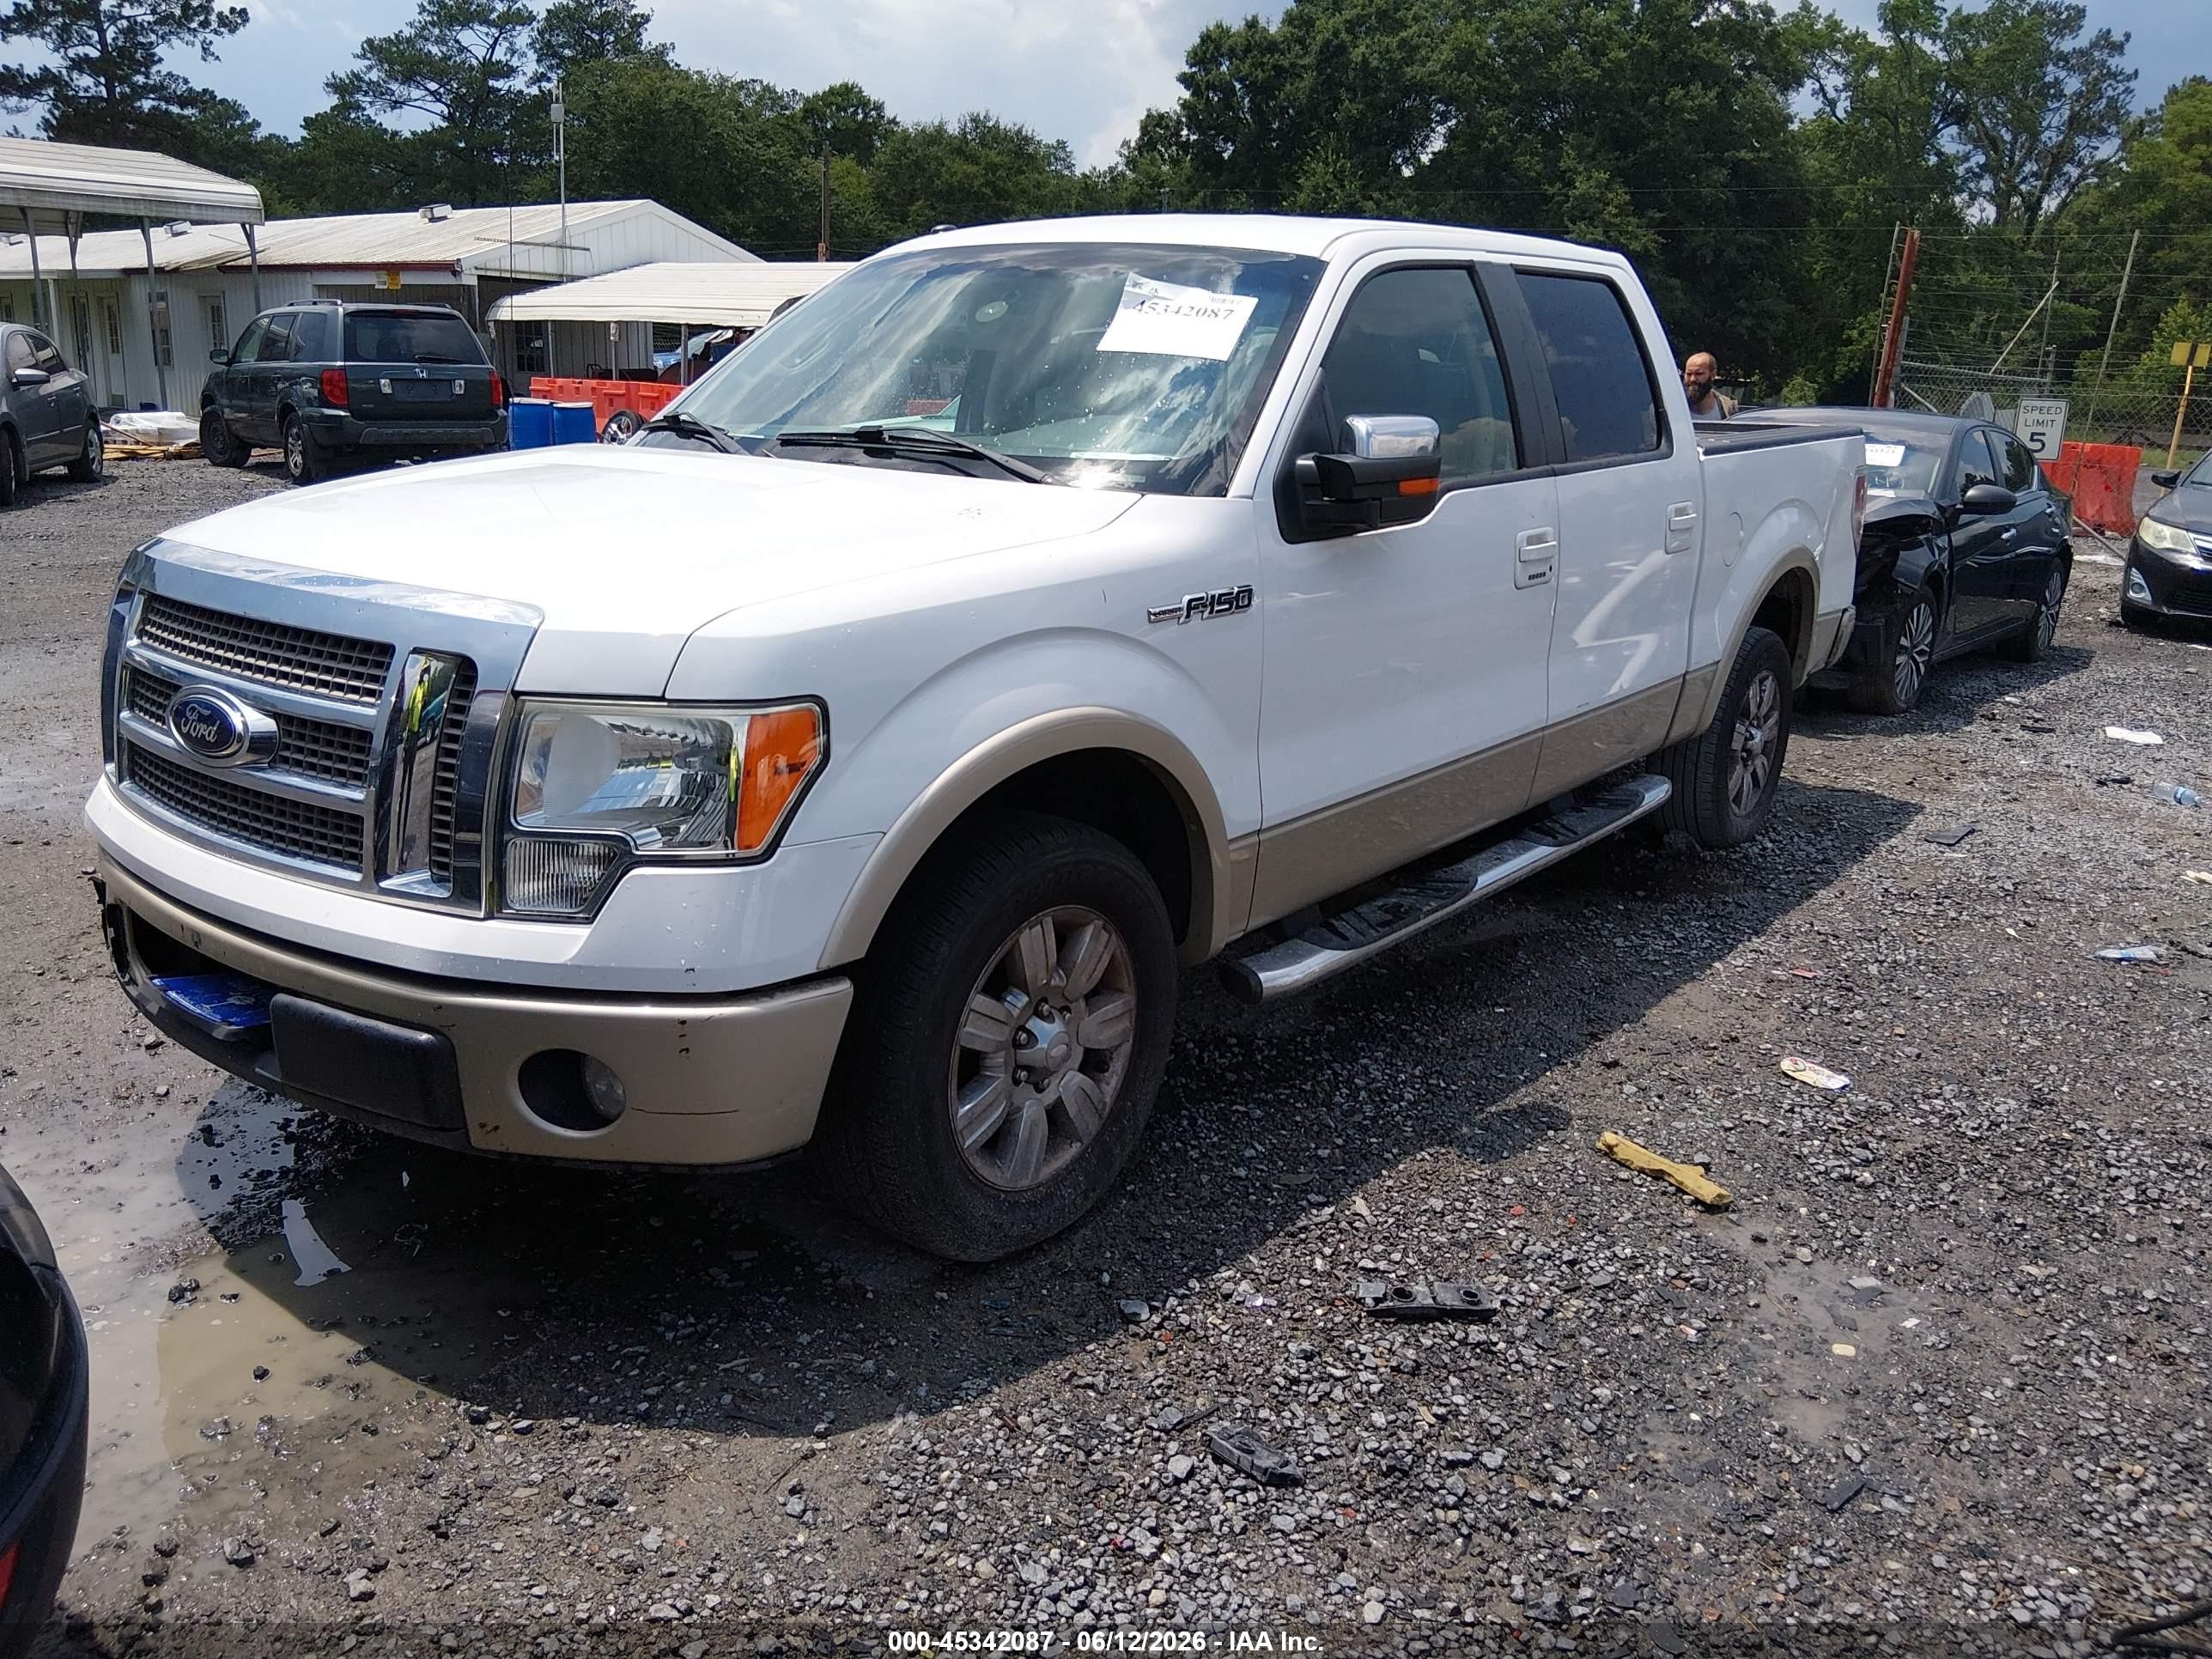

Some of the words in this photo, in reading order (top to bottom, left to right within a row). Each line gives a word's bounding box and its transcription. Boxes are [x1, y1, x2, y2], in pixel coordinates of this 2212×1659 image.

[1133, 300, 1234, 319] 45342087
[2022, 404, 2063, 415] SPEED
[2024, 418, 2057, 428] LIMIT
[2029, 431, 2046, 453] 5
[180, 703, 220, 743] Ford
